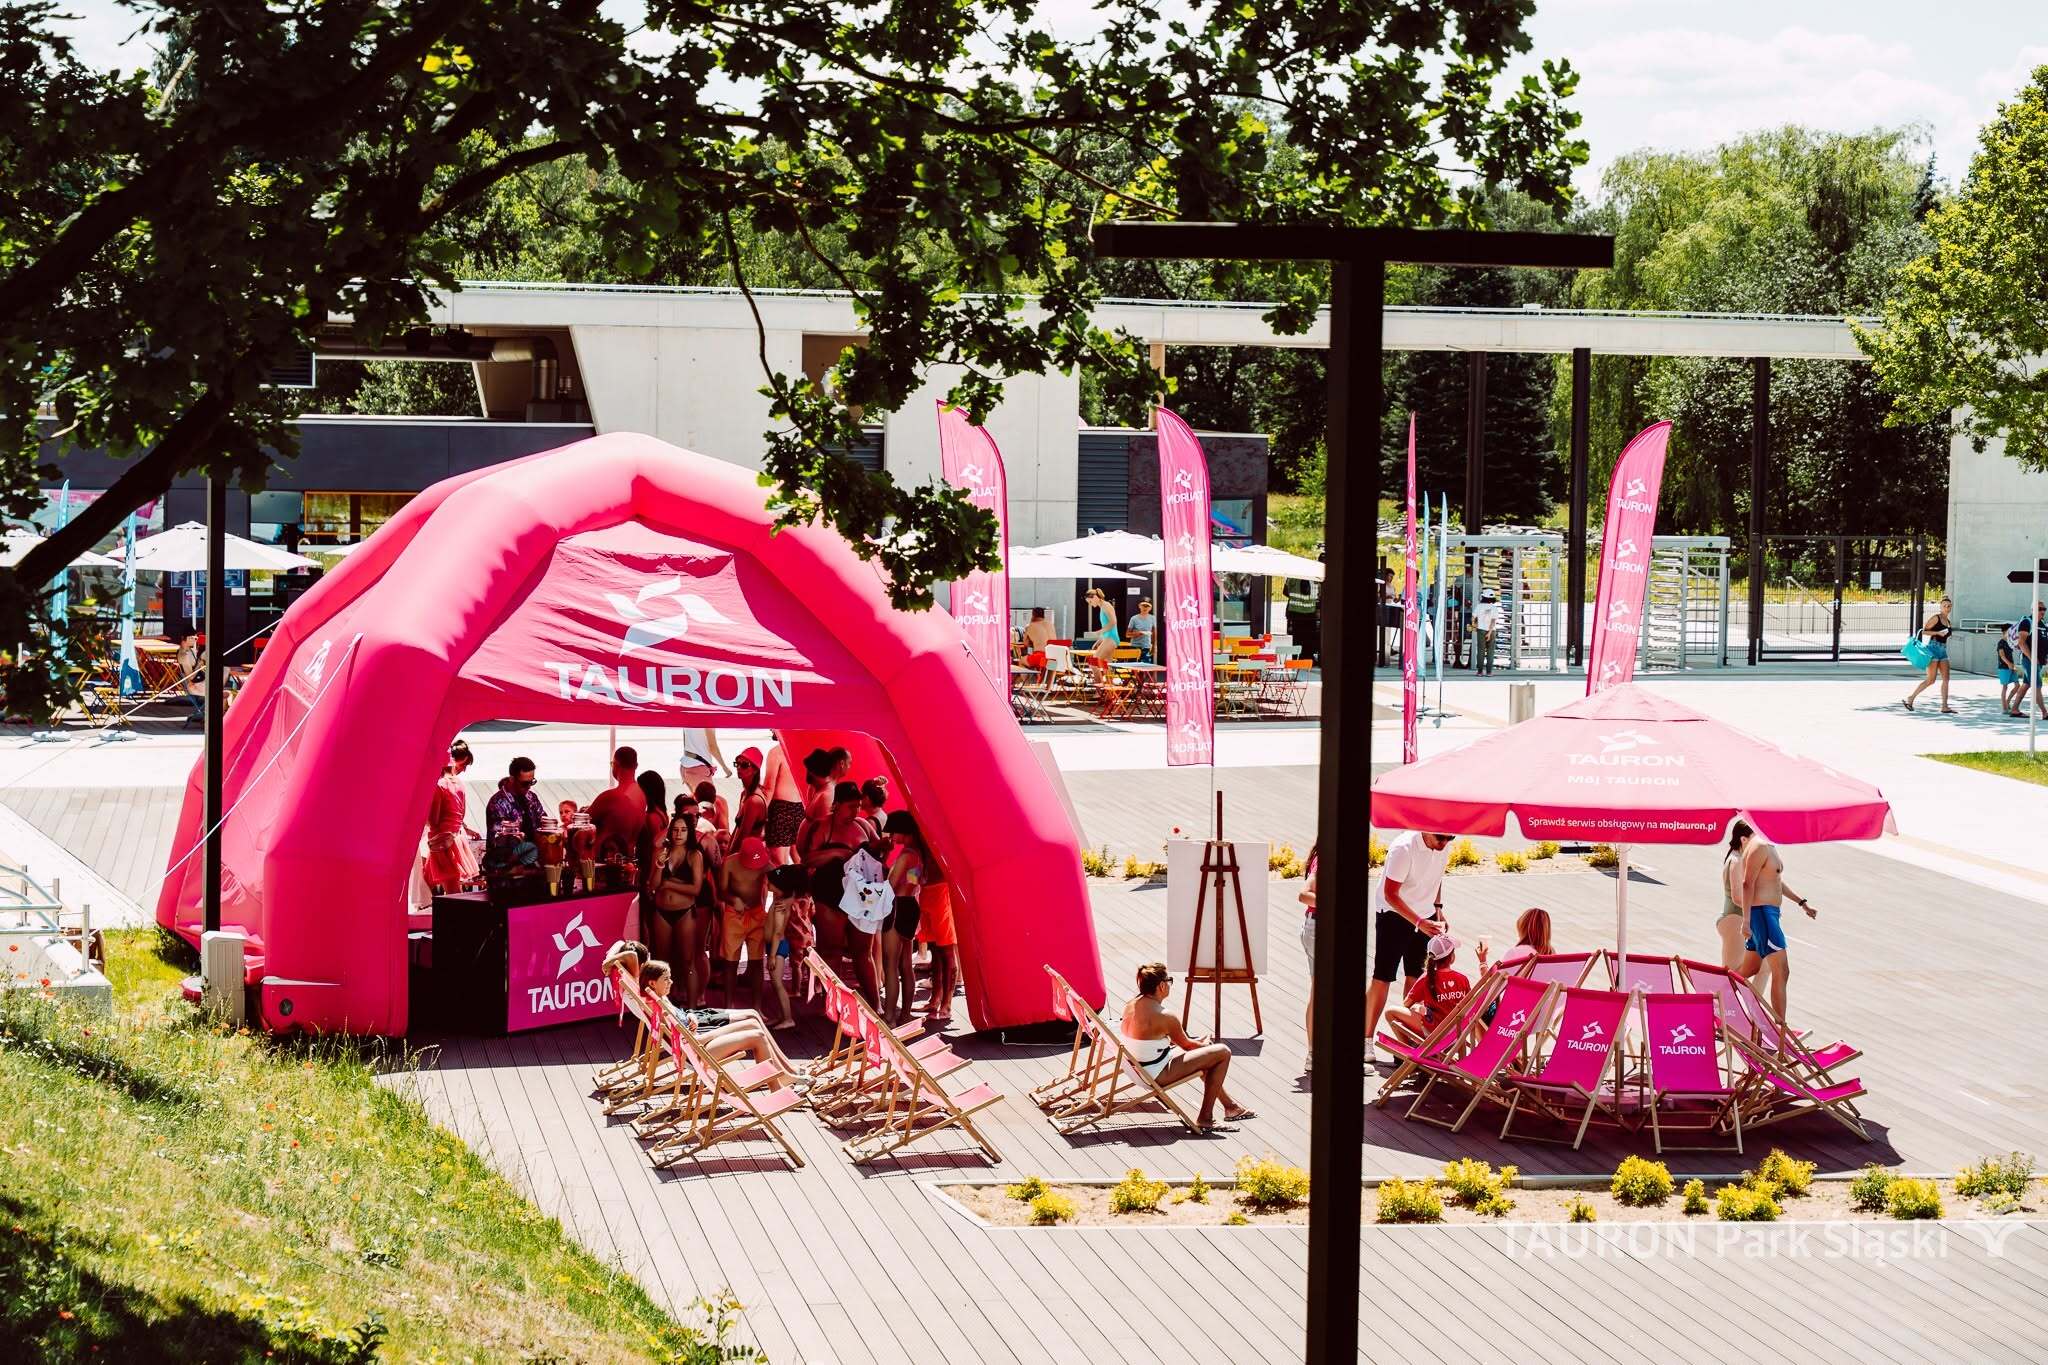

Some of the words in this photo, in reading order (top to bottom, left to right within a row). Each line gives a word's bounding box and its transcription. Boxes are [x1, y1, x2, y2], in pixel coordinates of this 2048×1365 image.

[1608, 559, 1644, 575] TURON
[543, 661, 793, 708] TAURON
[1566, 753, 1686, 767] TAURON
[1606, 776, 1681, 786] TAURON
[1567, 818, 1596, 828] serwis
[1597, 818, 1645, 831] obsługowy
[1646, 821, 1658, 829] na
[1659, 820, 1717, 832] mojtauron.pl
[1567, 1039, 1609, 1053] TAURON
[1659, 1045, 1706, 1056] TAURON
